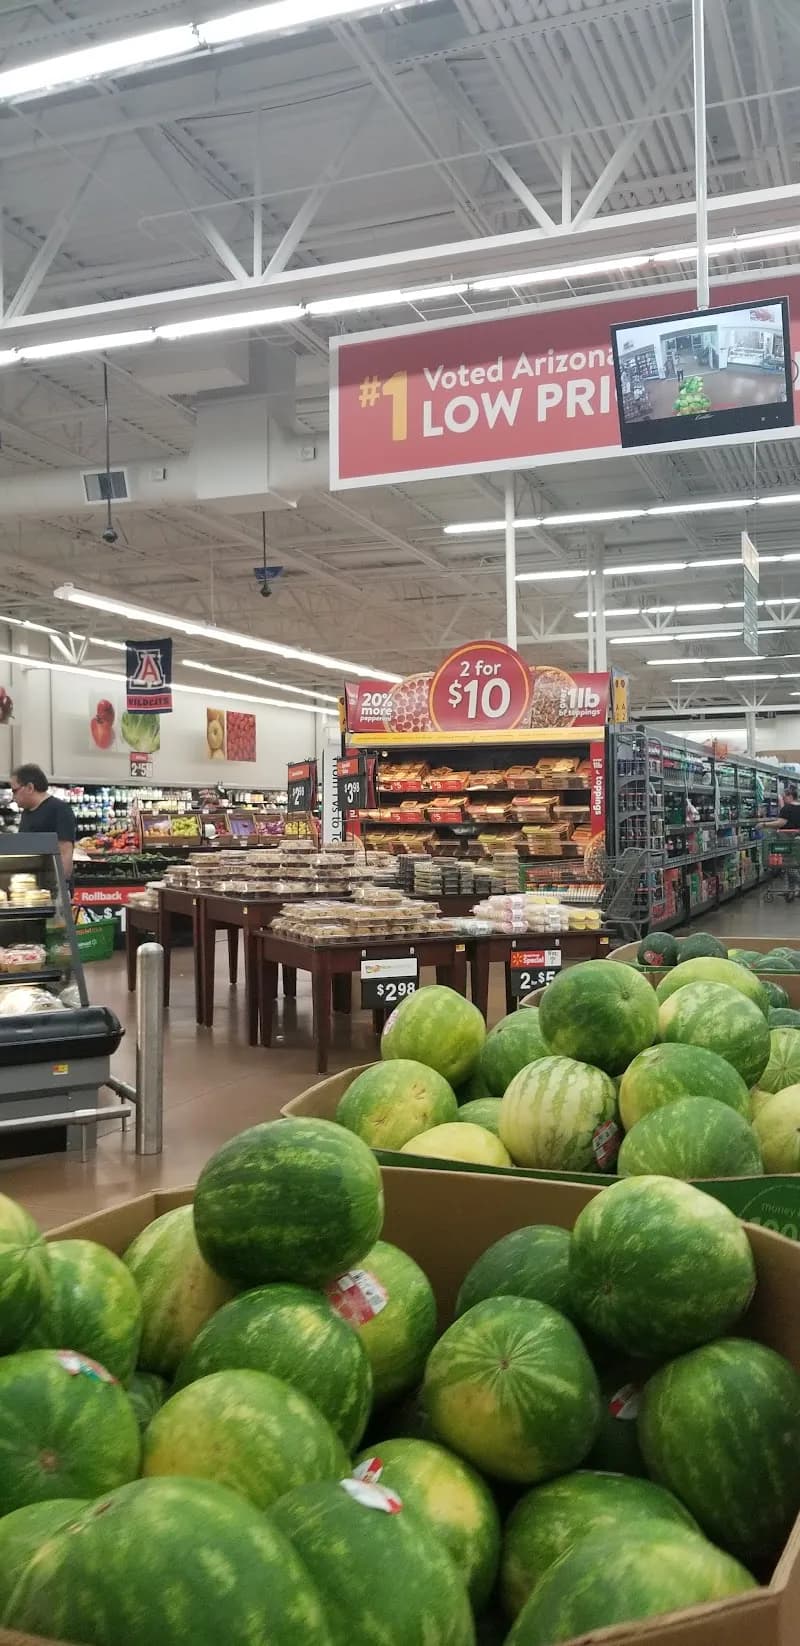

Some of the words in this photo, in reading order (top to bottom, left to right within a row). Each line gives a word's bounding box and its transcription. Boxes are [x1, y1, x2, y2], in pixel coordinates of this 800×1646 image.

[423, 355, 503, 392] Voted
[359, 370, 408, 441] #1
[423, 387, 523, 438] LOW
[537, 375, 617, 423] PRI
[128, 648, 167, 690] A
[459, 660, 471, 677] 2
[474, 659, 502, 676] for
[128, 695, 170, 706] WILDCATS
[361, 692, 393, 706] 20%
[361, 707, 393, 715] more
[447, 677, 511, 719] $10
[568, 708, 601, 717] toppings
[593, 776, 604, 815] toppings
[81, 891, 122, 901] Rollback
